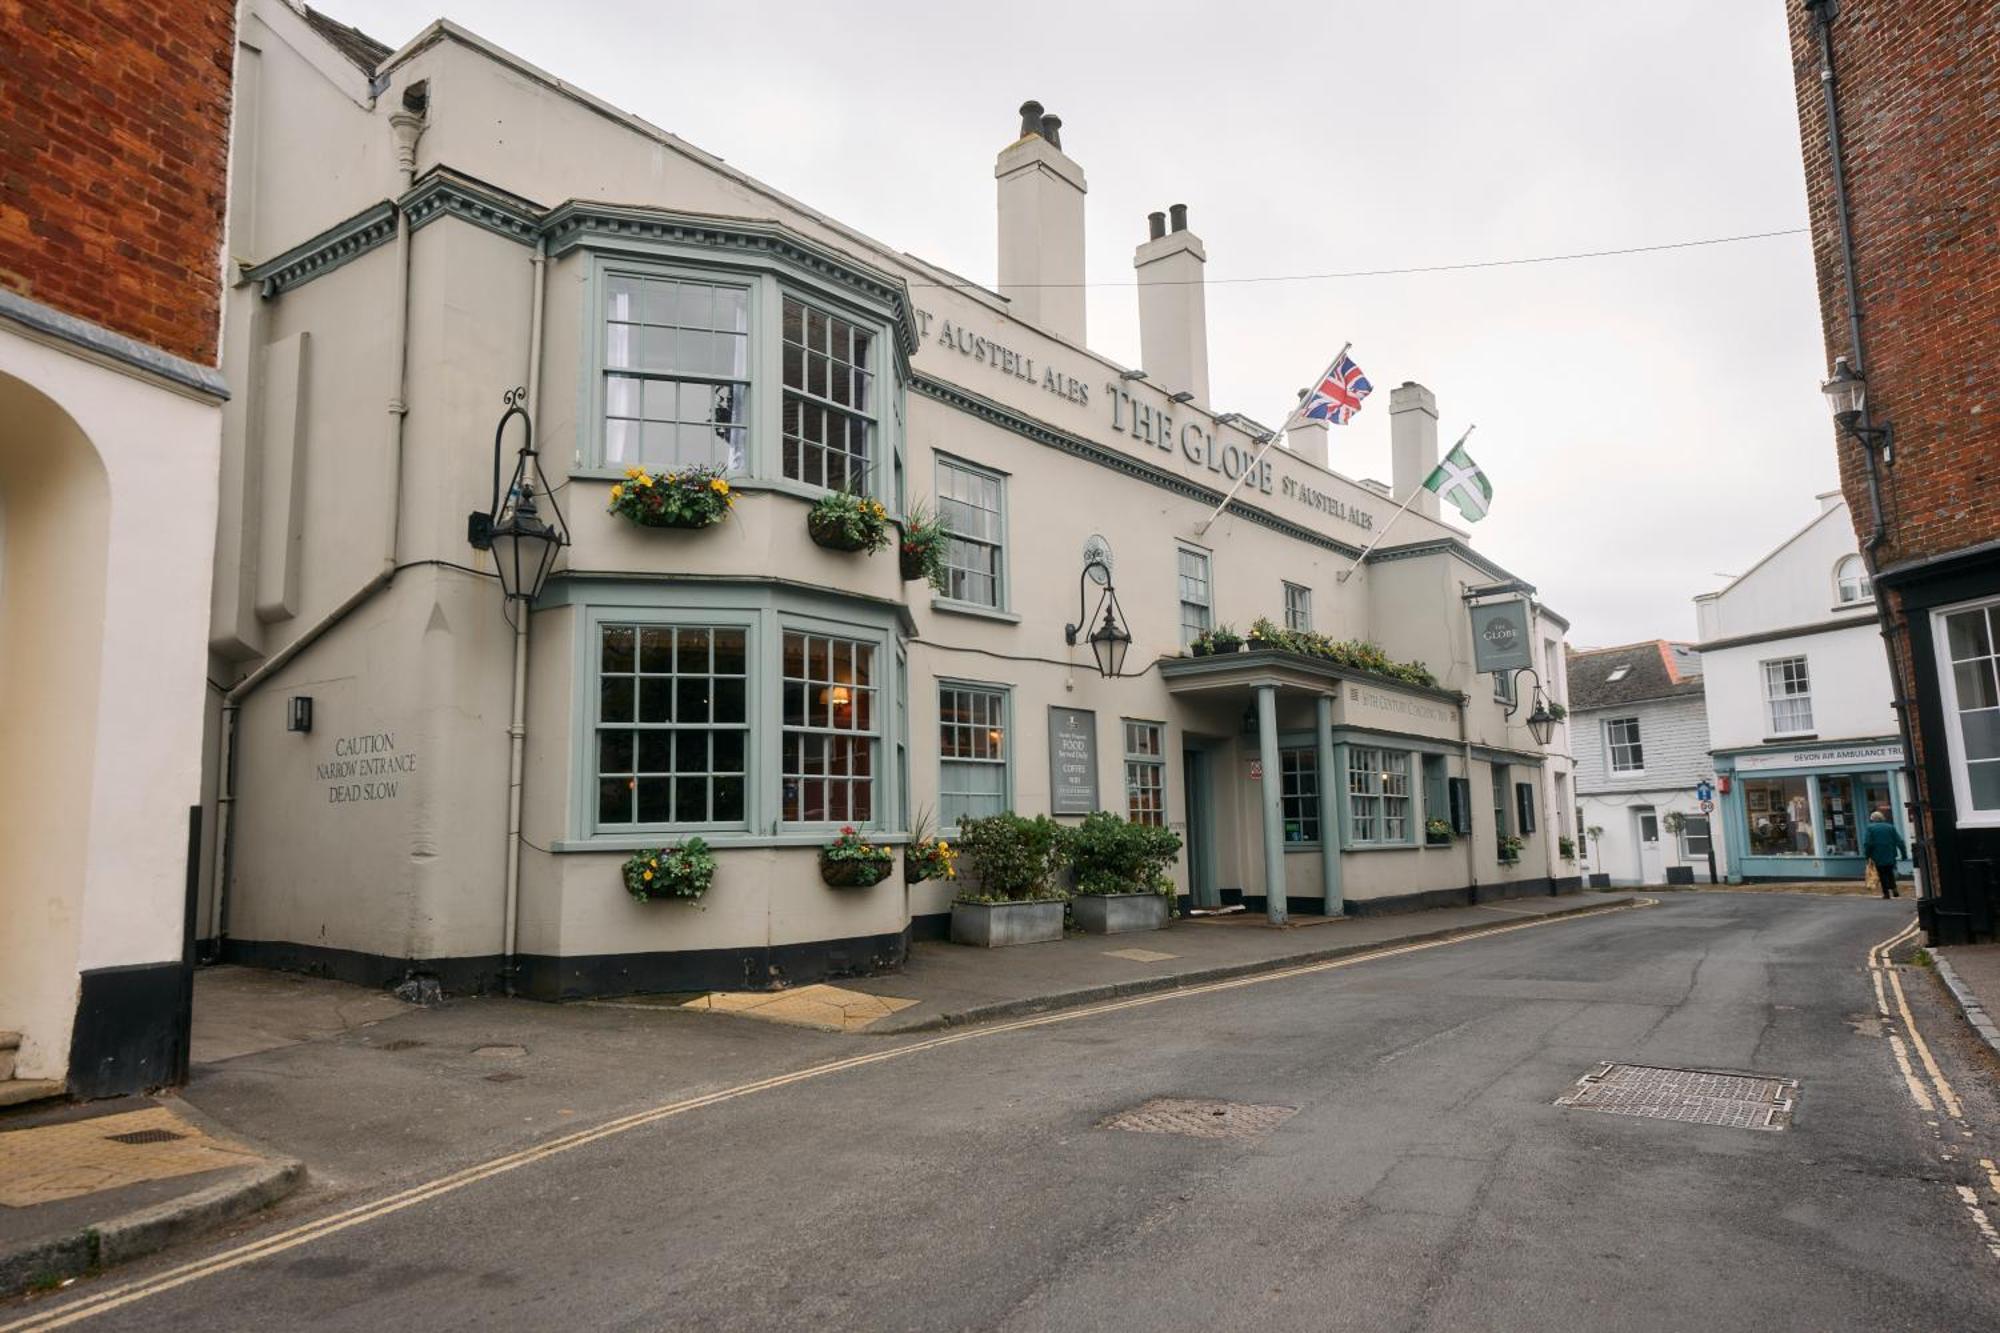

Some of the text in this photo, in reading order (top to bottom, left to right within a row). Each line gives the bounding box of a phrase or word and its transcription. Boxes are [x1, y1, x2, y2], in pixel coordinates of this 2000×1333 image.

[938, 319, 1038, 385] AUSTELL
[1042, 366, 1089, 408] ALES
[1106, 381, 1273, 497] THE GLOBE
[1282, 475, 1373, 531] ST AUSTELL ALES
[1483, 628, 1517, 641] GLOBE
[335, 732, 395, 757] CAUTION
[1062, 739, 1085, 752] FOOD
[1794, 754, 1821, 762] DEVON
[1822, 752, 1835, 760] AIR
[1836, 748, 1886, 759] AMBULANCE
[317, 753, 416, 780] NARROW ENTRANCE
[328, 781, 399, 803] DEAD SLOW
